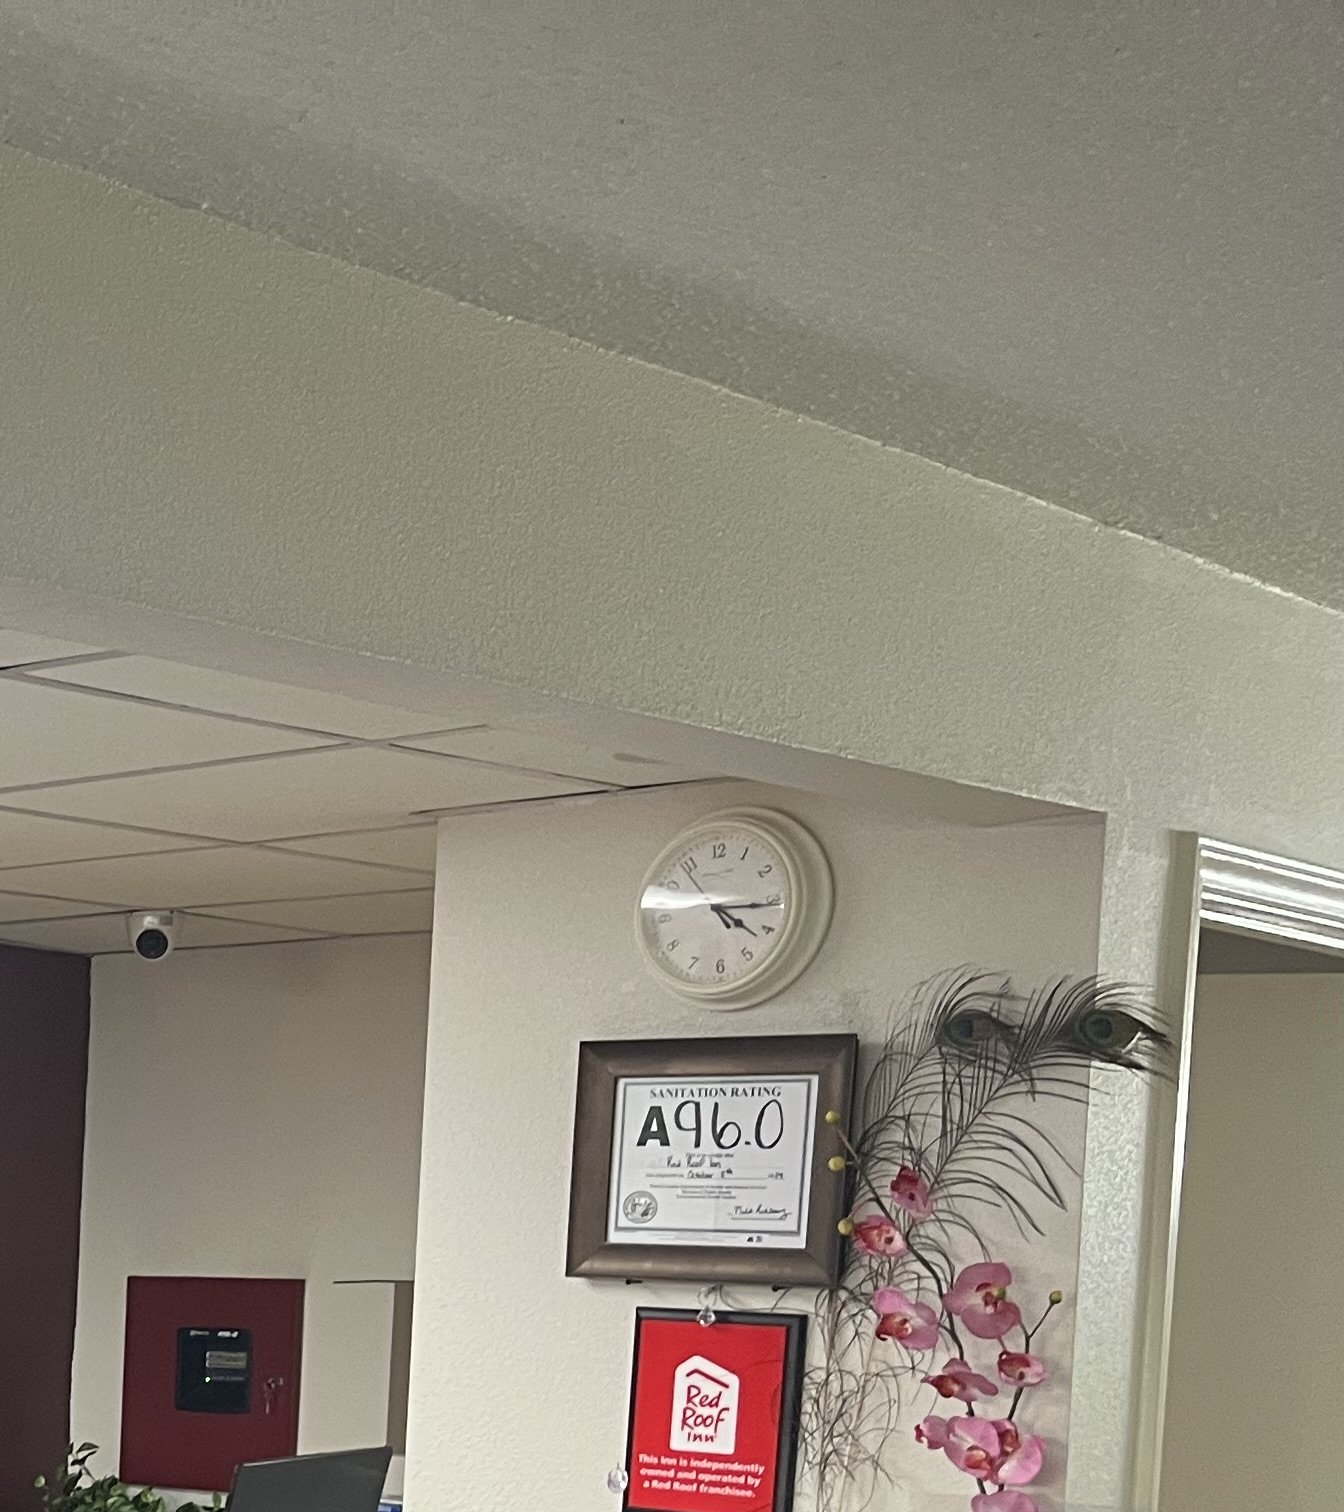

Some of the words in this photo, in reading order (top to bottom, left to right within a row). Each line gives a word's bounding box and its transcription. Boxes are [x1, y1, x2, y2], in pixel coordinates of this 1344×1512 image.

[711, 842, 726, 859] 12
[740, 846, 749, 860] 1
[681, 855, 698, 874] 11
[758, 864, 773, 878] 2
[766, 894, 781, 904] 3
[658, 913, 672, 924] 9
[762, 924, 775, 935] 4
[666, 939, 680, 951] 8
[741, 946, 753, 962] 5
[688, 956, 700, 970] 7
[715, 958, 725, 974] 6
[649, 1087, 727, 1099] SANITATION
[730, 1086, 782, 1098] RATING
[686, 1384, 722, 1409] Red
[680, 1406, 730, 1434] Roof
[638, 1453, 659, 1465] This
[679, 1457, 688, 1467] is
[689, 1458, 765, 1476] independently
[639, 1468, 675, 1478] owned
[676, 1470, 697, 1480] and
[698, 1473, 746, 1484] operated
[747, 1475, 761, 1488] by
[643, 1480, 650, 1489] a
[651, 1480, 672, 1490] Red
[672, 1481, 698, 1492] Roof
[699, 1483, 756, 1498] franchisee.
